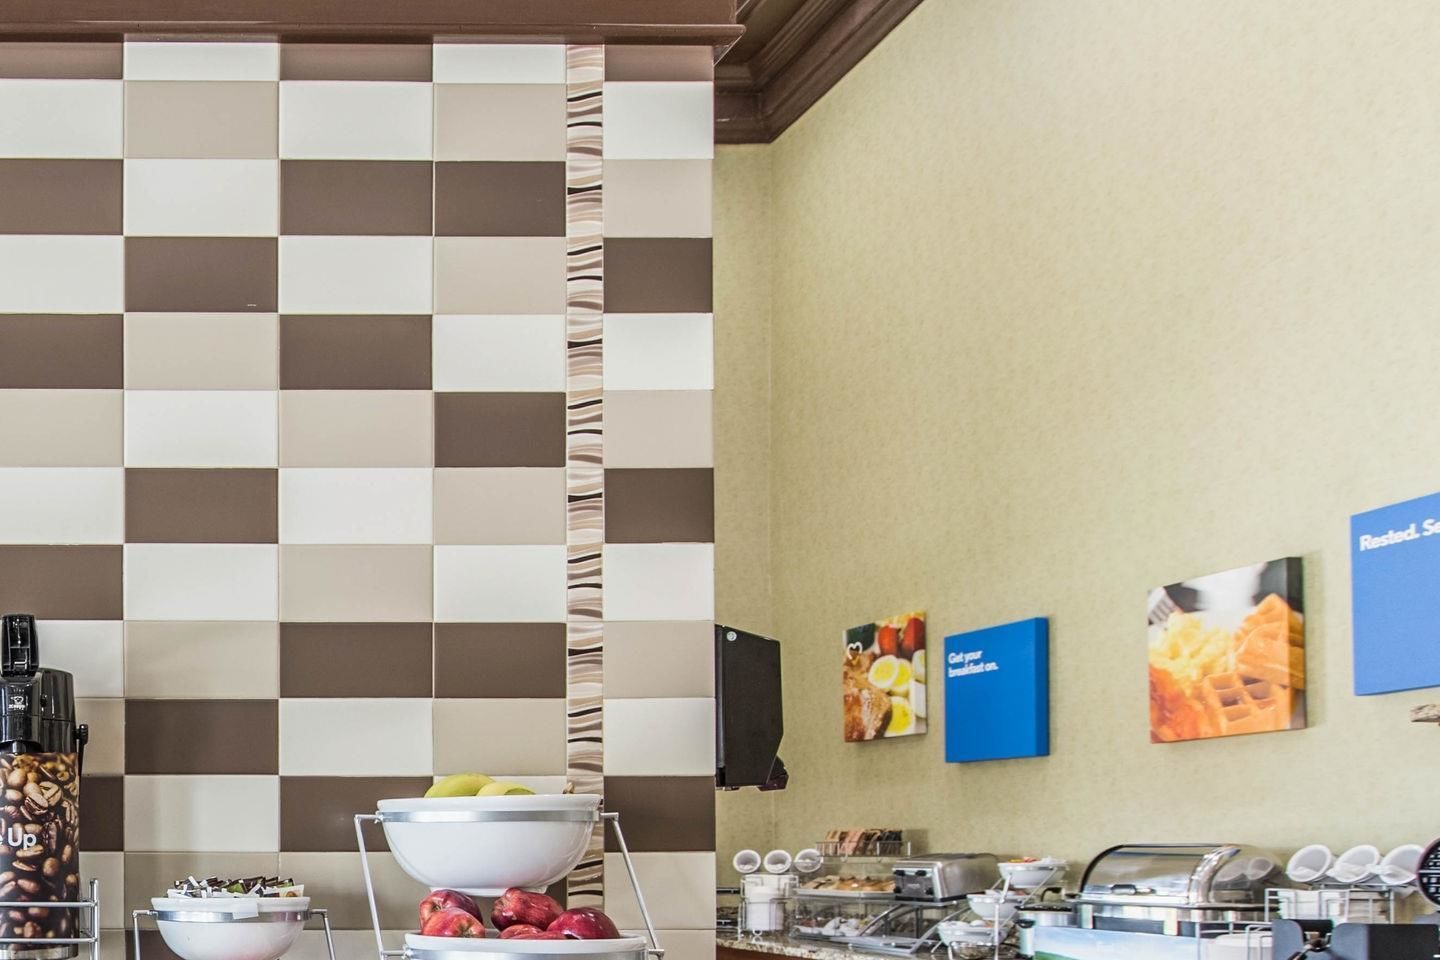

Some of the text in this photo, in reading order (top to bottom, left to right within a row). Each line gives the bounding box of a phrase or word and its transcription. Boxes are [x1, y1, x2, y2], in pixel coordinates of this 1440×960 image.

[1359, 523, 1420, 552] Rested.
[948, 652, 963, 664] Get
[7, 827, 37, 851] Up
